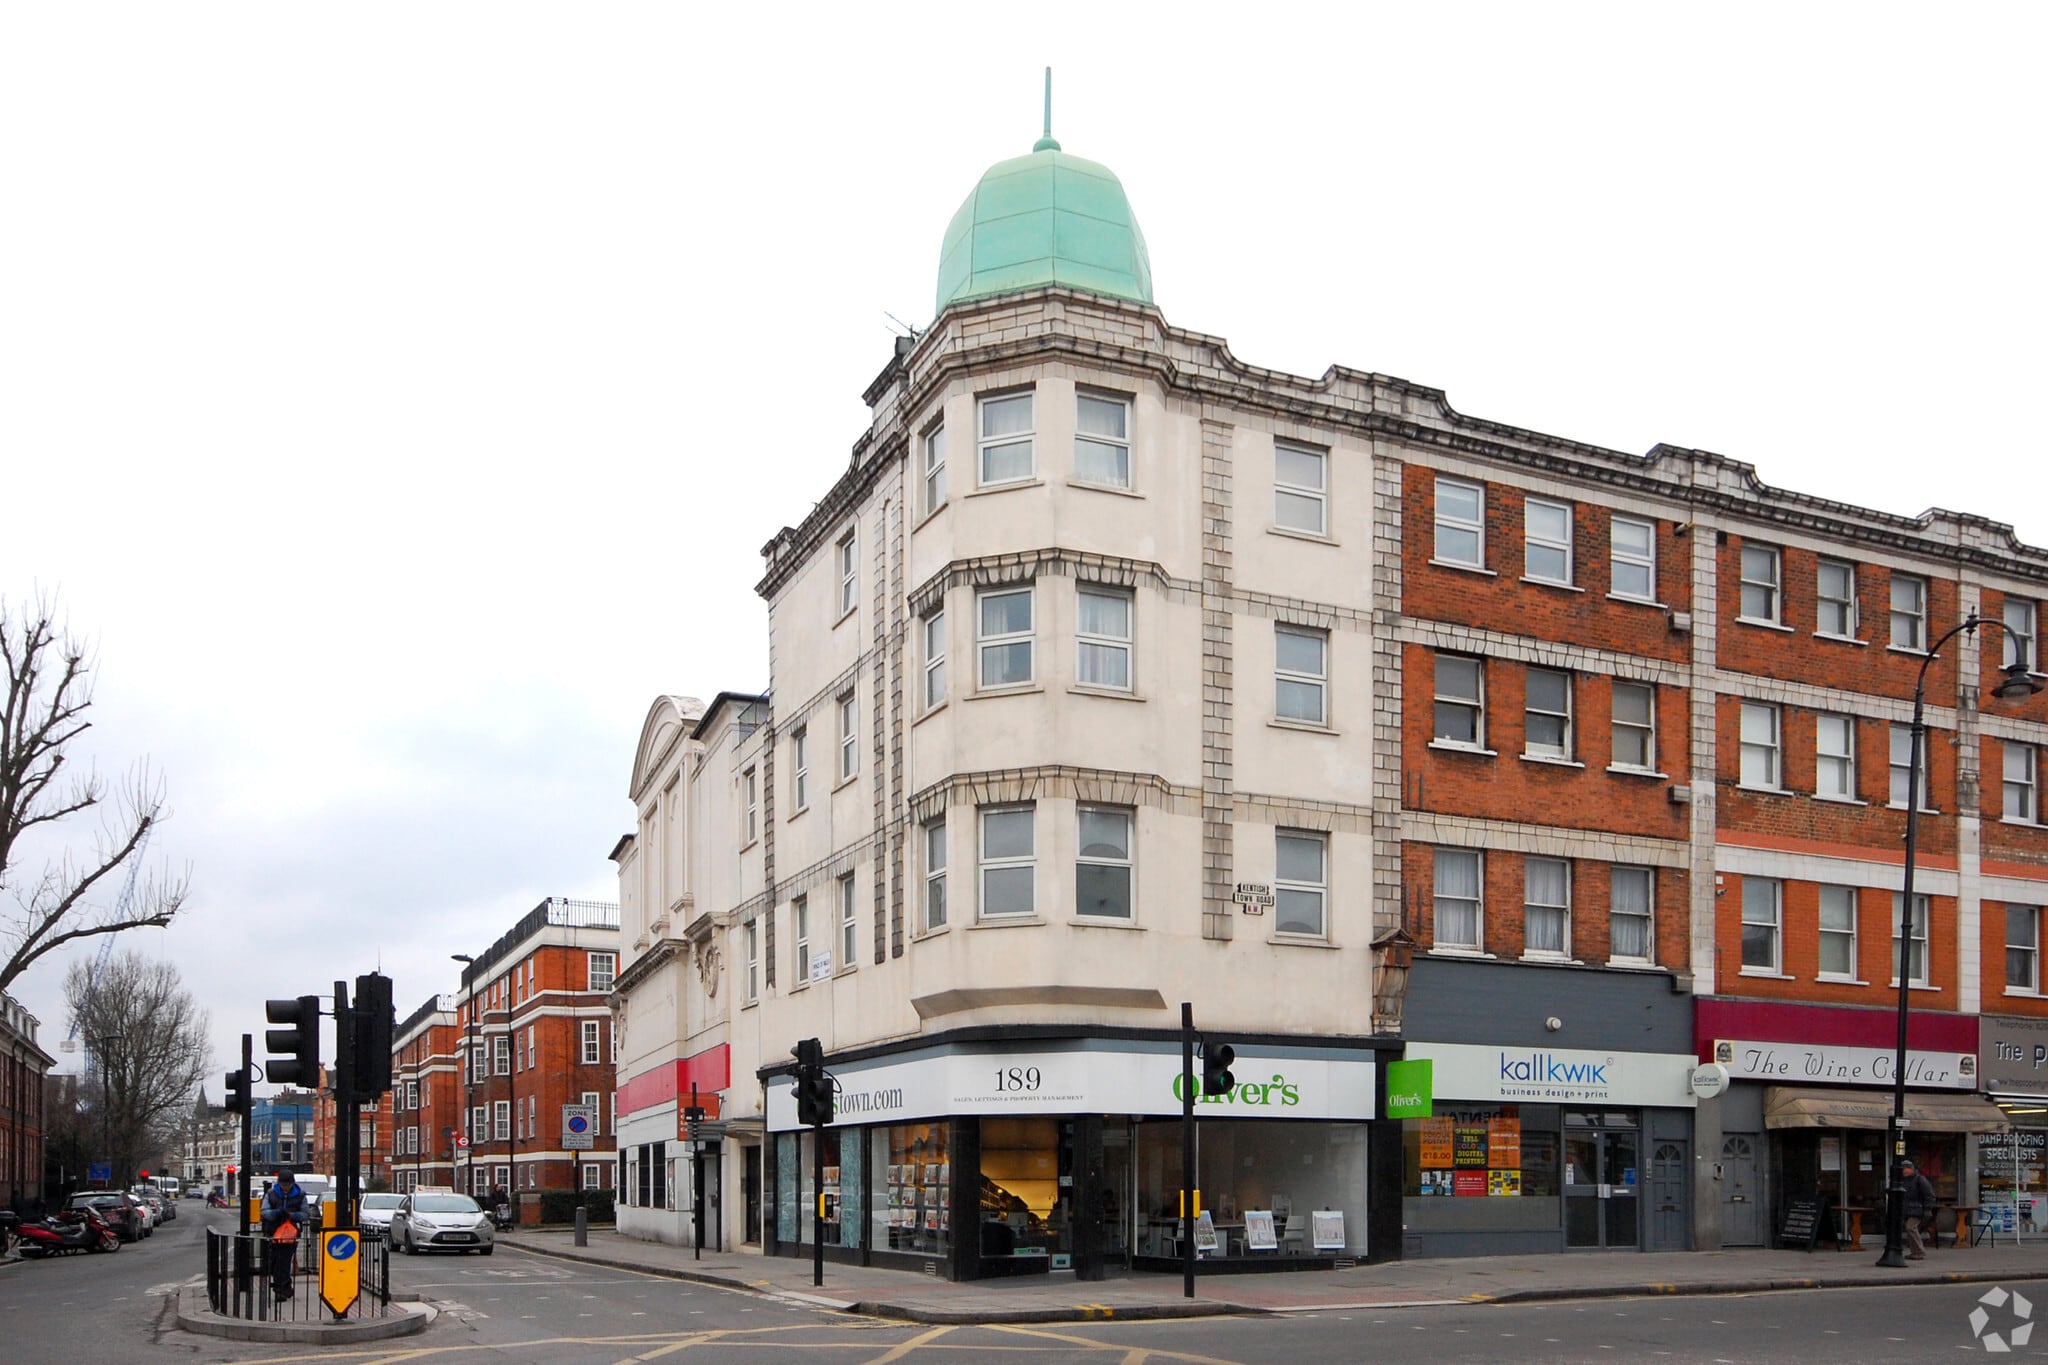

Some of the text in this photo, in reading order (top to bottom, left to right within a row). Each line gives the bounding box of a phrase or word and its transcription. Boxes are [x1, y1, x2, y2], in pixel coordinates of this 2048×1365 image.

[1995, 1042, 2023, 1060] The
[1743, 1049, 1789, 1075] The
[1804, 1051, 1862, 1078] Wine
[995, 1066, 1041, 1092] 189
[1172, 1072, 1300, 1106] Over's
[1500, 1088, 1541, 1096] business
[1545, 1089, 1575, 1099] design
[1584, 1090, 1608, 1099] print
[1390, 1093, 1422, 1107] Oliver's
[1979, 1134, 2045, 1146] DAMP PROOFING
[1987, 1148, 2037, 1160] SPECIALISTS
